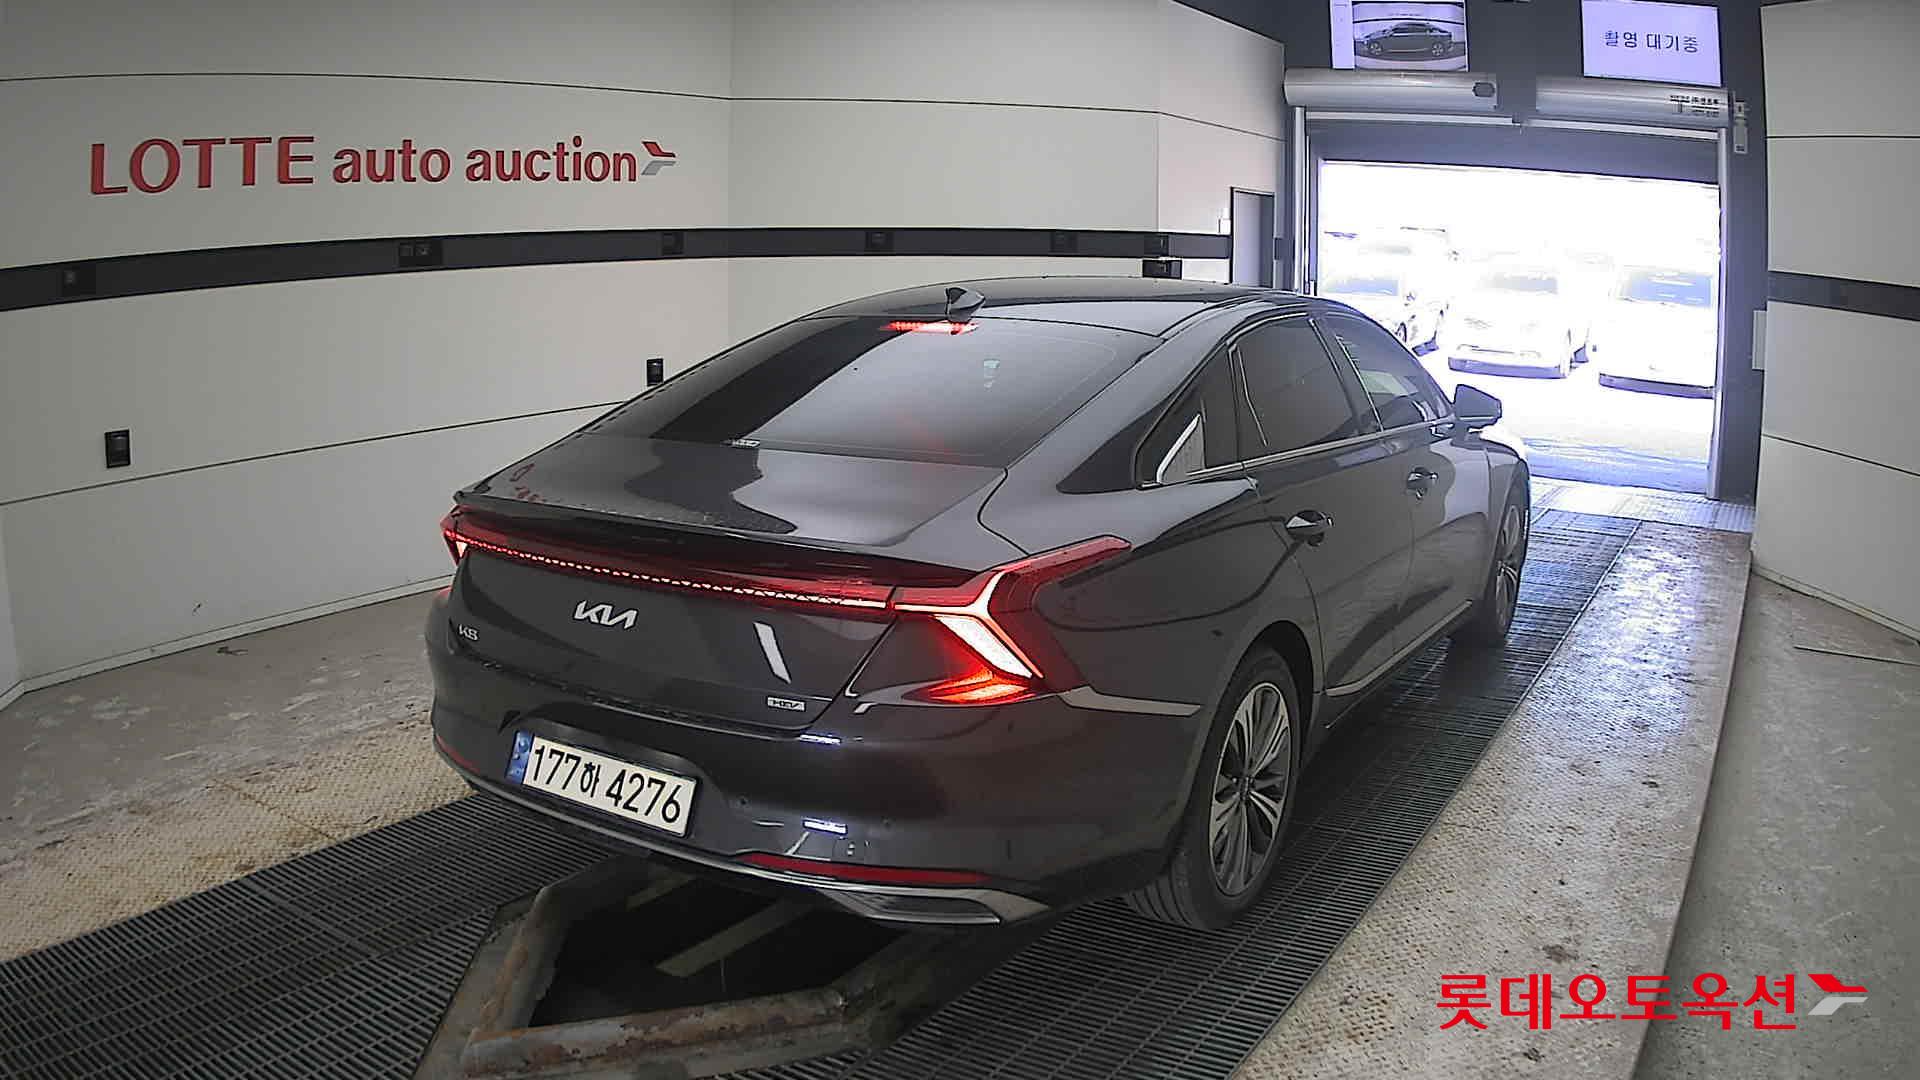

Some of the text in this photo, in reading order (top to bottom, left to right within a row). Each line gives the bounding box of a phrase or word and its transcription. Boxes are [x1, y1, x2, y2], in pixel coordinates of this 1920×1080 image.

[1646, 33, 1698, 53] 대기중
[91, 135, 637, 194] LOTTE auto auction
[574, 600, 638, 630] KIA
[533, 745, 681, 823] 177하 4276
